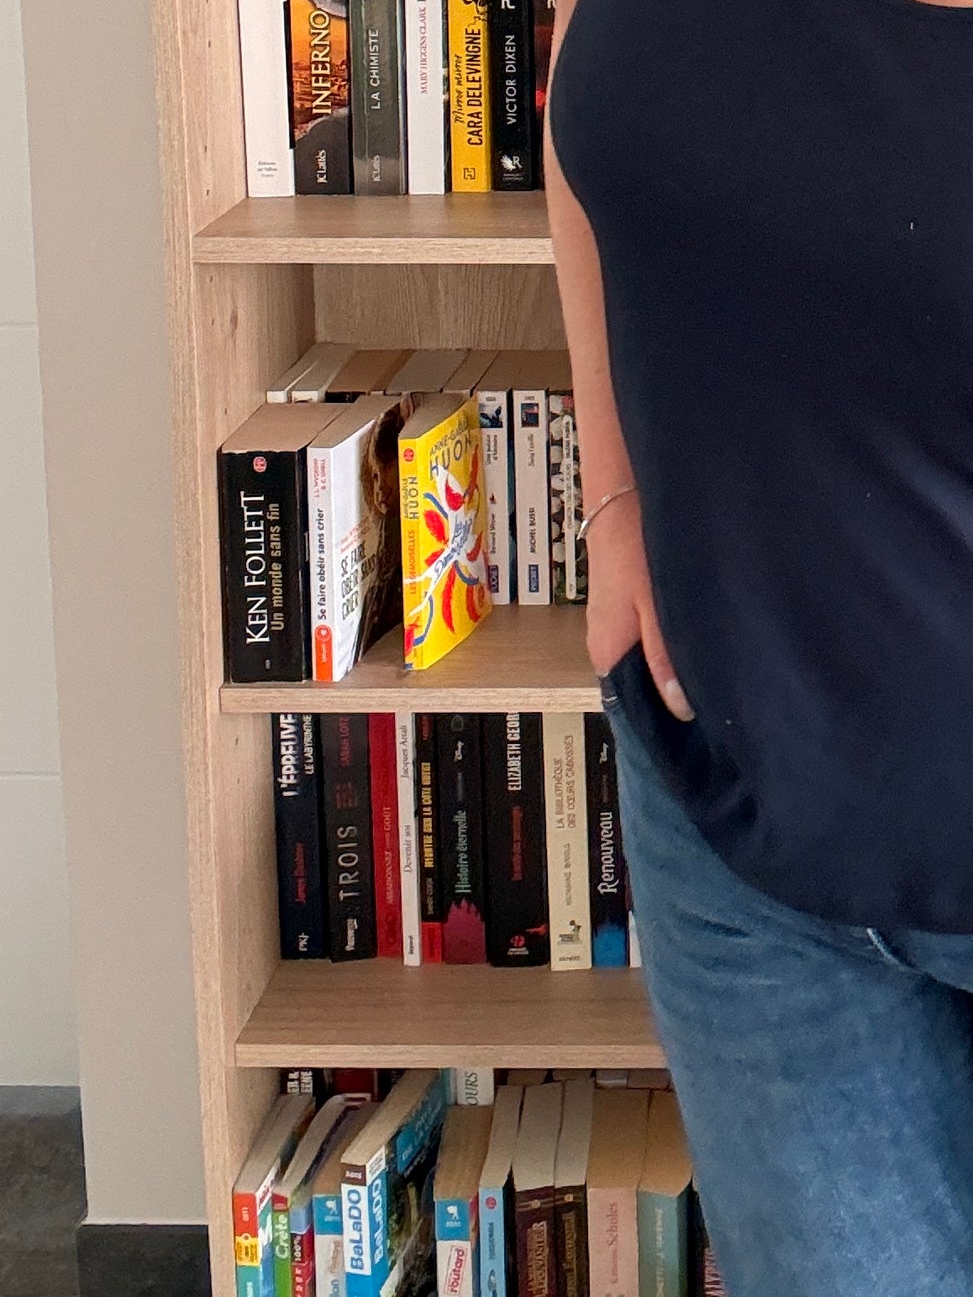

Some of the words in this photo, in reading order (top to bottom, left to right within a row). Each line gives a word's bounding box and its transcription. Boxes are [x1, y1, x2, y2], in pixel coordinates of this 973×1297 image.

[310, 9, 332, 114] INFERNO
[369, 29, 380, 87] CHIMISTE
[465, 28, 482, 106] DELEVINGNE
[505, 35, 516, 73] DIXEN
[371, 92, 381, 109] LA
[506, 79, 518, 124] VICTOR
[467, 111, 483, 145] CARA
[430, 434, 472, 480] HUON
[266, 503, 279, 521] fin
[315, 508, 324, 531] crier
[408, 476, 419, 520] HUON
[240, 490, 266, 587] FOLLETT
[268, 525, 281, 557] sans
[317, 532, 325, 554] sans
[268, 562, 283, 607] monde
[315, 556, 325, 582] obéir
[317, 584, 326, 606] faire
[318, 608, 327, 620] Se
[246, 596, 270, 644] KEN
[270, 612, 284, 631] Un
[277, 713, 300, 797] L'ÉPREUVE
[304, 764, 315, 774] LE
[507, 743, 522, 790] ELIZABETH
[452, 810, 468, 851] éternelle
[598, 811, 619, 894] Renouveau
[337, 826, 360, 901] TROIS
[454, 852, 472, 893] Histoire
[275, 1214, 289, 1259] Crète
[447, 1248, 466, 1294] routard
